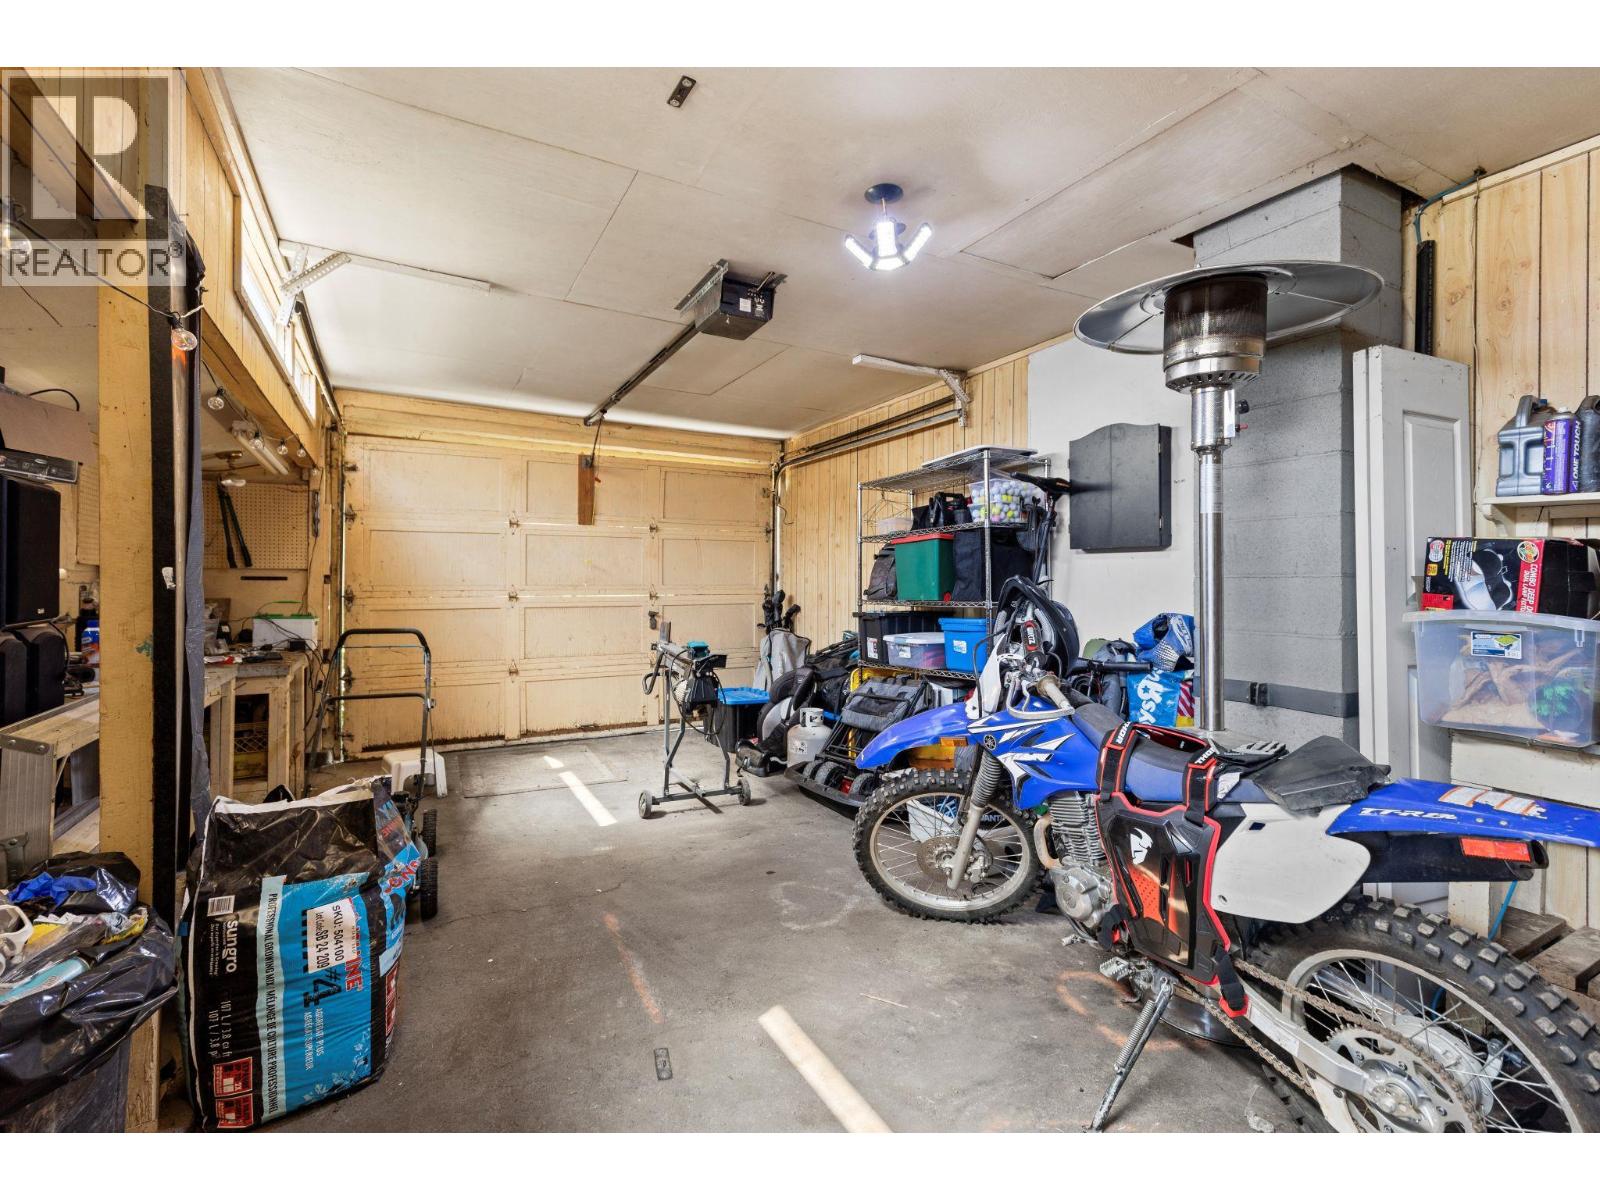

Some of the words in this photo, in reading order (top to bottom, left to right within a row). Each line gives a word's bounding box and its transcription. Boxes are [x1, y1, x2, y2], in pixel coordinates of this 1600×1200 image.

[1573, 421, 1581, 457] TOUCH
[1529, 563, 1538, 587] COMBO
[1527, 588, 1536, 605] DEEP
[264, 893, 278, 941] PROFESSIONAL
[333, 905, 344, 928] SKU:
[222, 920, 239, 973] sungro
[264, 942, 275, 973] GROWING
[316, 942, 329, 953] 24
[333, 929, 345, 962] 504100
[316, 953, 330, 969] 209
[266, 974, 275, 986] MIX
[208, 1009, 219, 1021] 107
[220, 1000, 231, 1012] 107
[265, 989, 277, 1021] MÉLANGE
[267, 1021, 276, 1031] DE
[267, 1031, 277, 1060] CULTURE
[267, 1061, 279, 1114] PROFESSIONNEL
